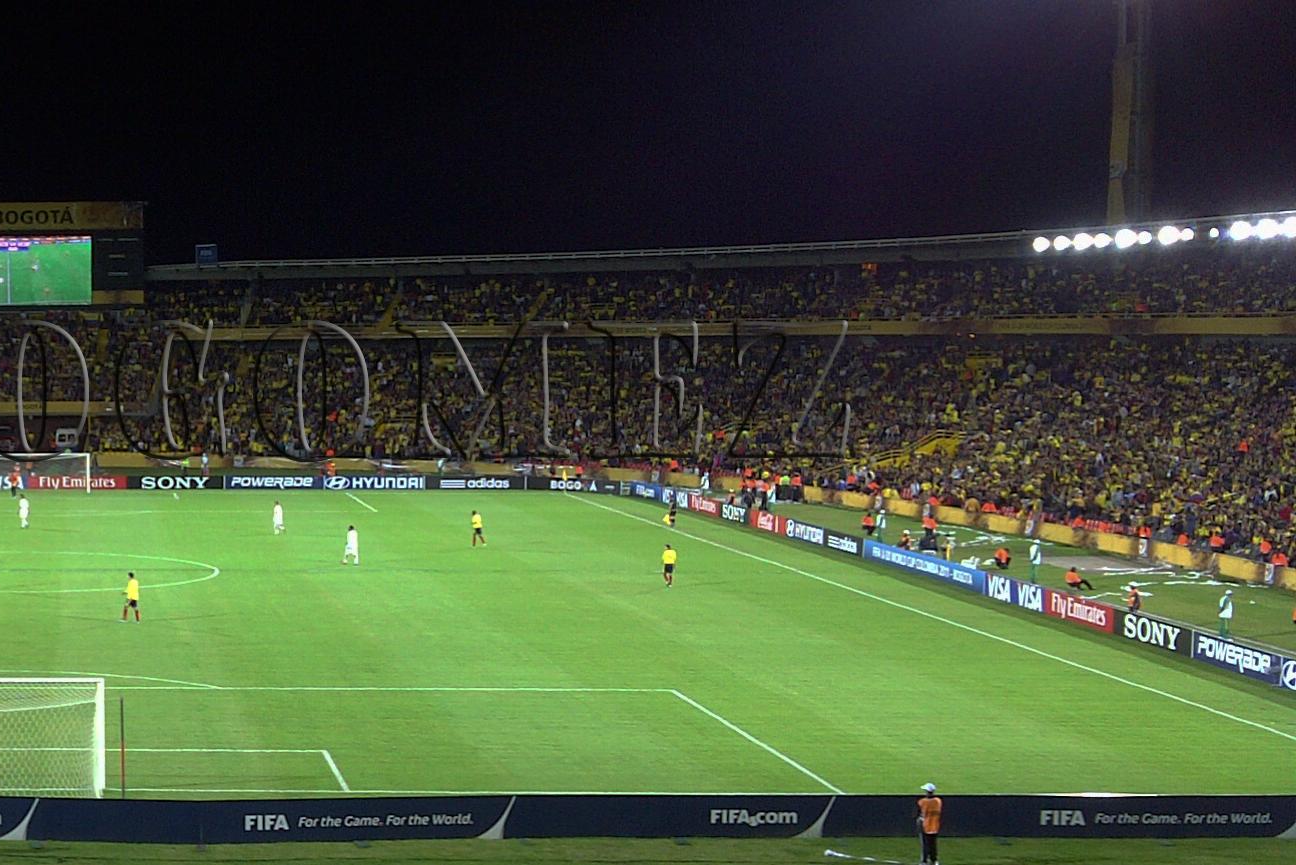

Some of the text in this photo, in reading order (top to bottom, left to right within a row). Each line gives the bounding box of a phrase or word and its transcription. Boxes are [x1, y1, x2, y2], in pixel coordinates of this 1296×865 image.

[39, 476, 60, 490] Fly
[141, 476, 209, 490] SONY
[231, 476, 314, 490] POWERADE
[352, 476, 424, 489] HYUNDAI
[467, 477, 510, 489] adidas
[722, 504, 746, 523] SONY
[988, 574, 1011, 603] VISA
[1017, 583, 1043, 612] VISA
[1051, 592, 1106, 626] Fly Emirates
[1124, 613, 1181, 650] SONY
[1197, 636, 1272, 674] POWERADE
[244, 813, 474, 832] FIFA For the Game. For the World.
[710, 809, 798, 828] FIFA.com
[1039, 810, 1273, 827] FIFA For the Game. For the World.
